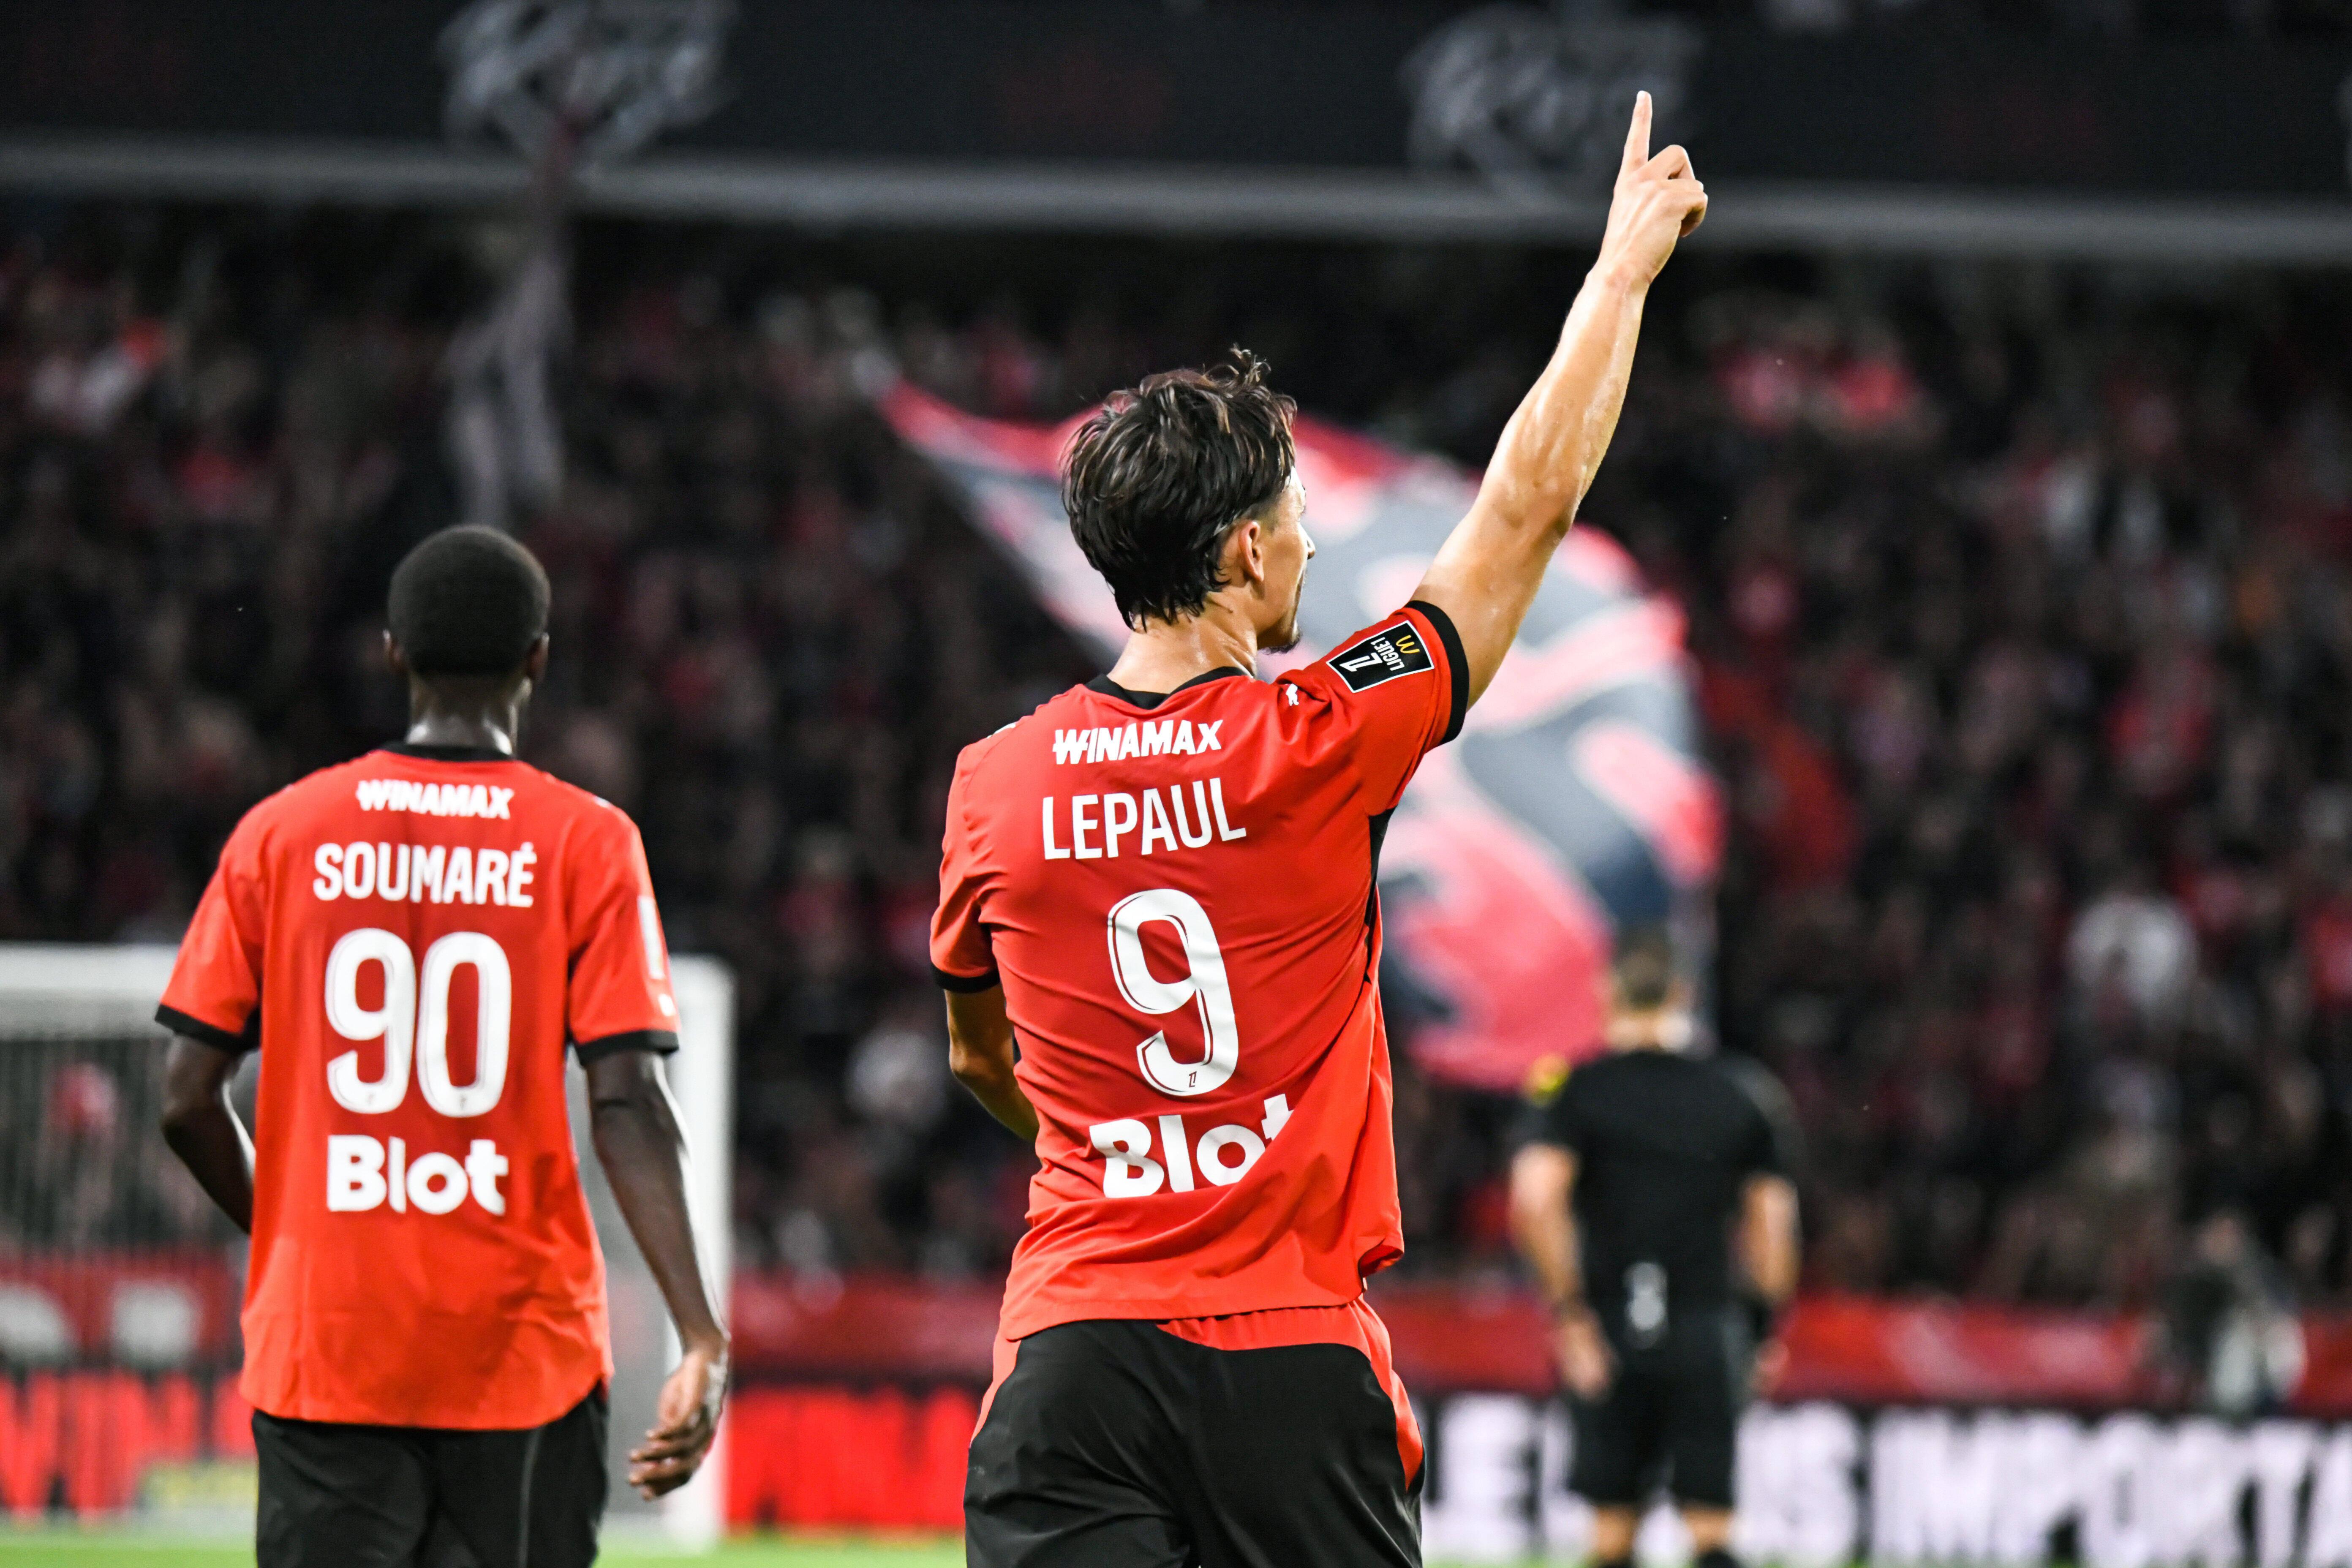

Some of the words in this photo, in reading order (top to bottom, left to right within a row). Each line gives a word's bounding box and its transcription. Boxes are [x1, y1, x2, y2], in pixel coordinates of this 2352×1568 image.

[1052, 719, 1224, 765] WINAMAX
[355, 779, 515, 819] WINAMAX
[1042, 777, 1247, 860] LEPAUL
[313, 841, 537, 907] SOUMARÉ
[324, 928, 512, 1117] 90
[1107, 888, 1239, 1097] 9
[326, 1135, 508, 1215] Blot
